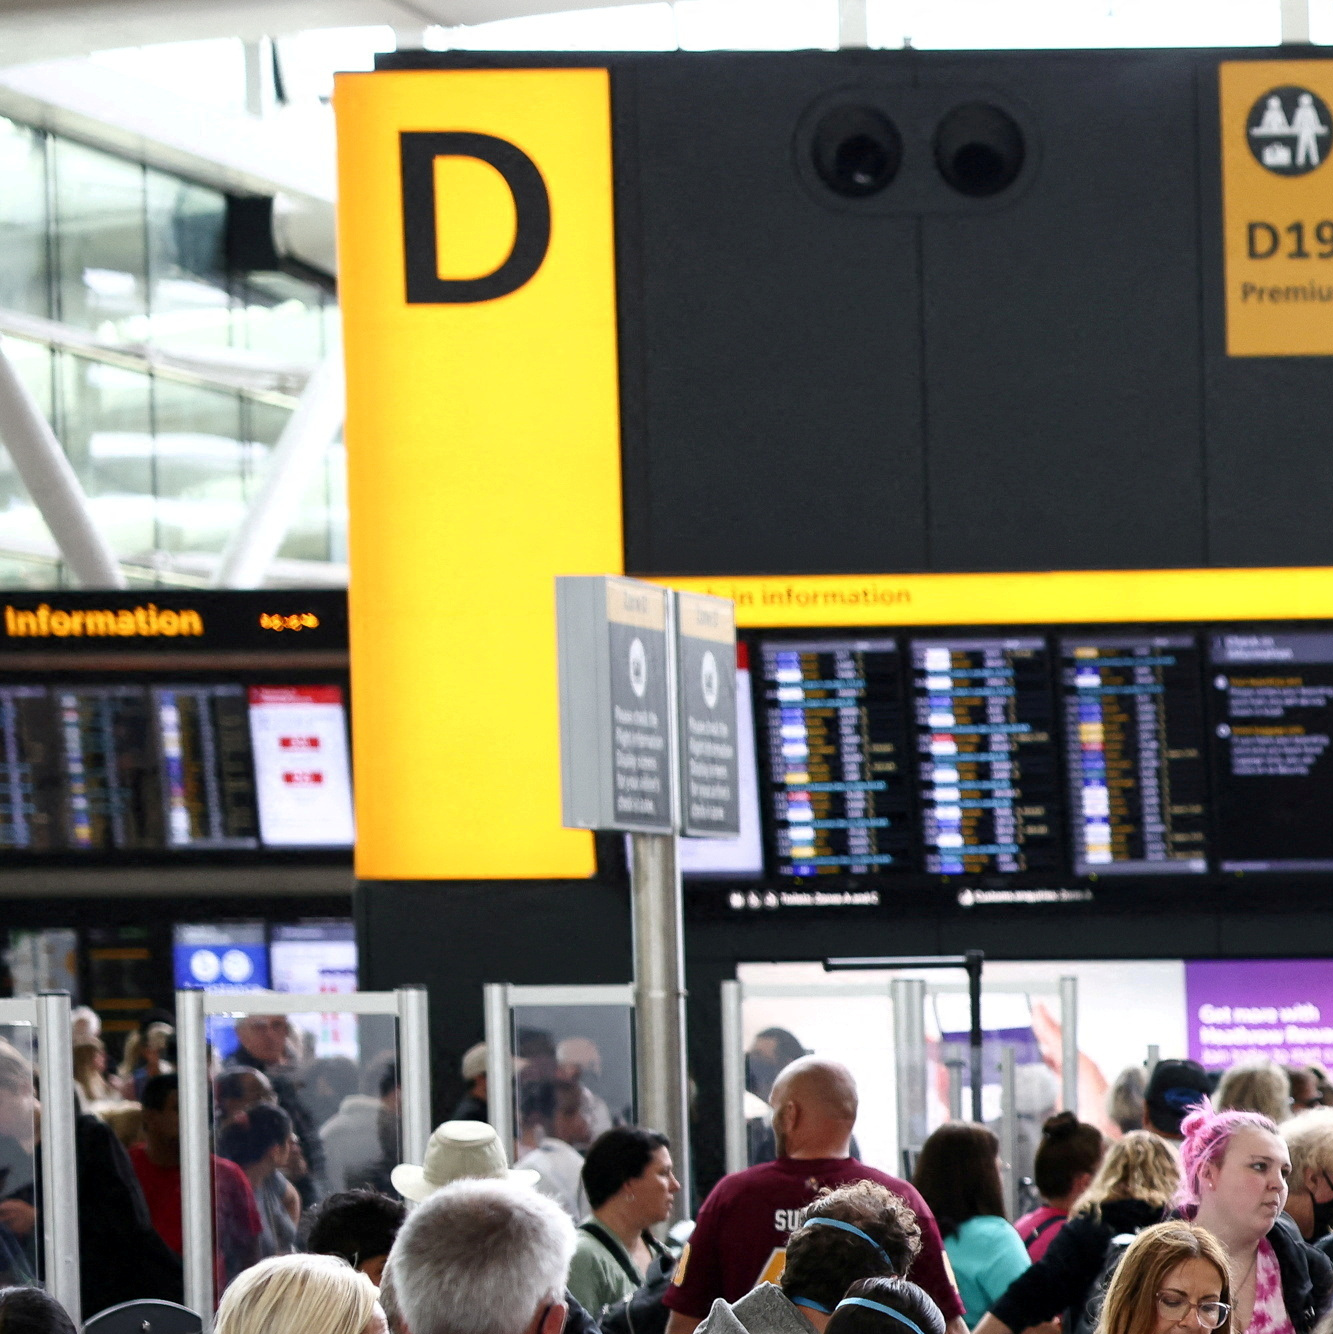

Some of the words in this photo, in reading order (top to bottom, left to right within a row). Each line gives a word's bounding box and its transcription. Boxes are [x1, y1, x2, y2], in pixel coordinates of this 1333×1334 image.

[398, 131, 552, 306] D
[762, 585, 912, 607] information
[4, 603, 205, 638] Information
